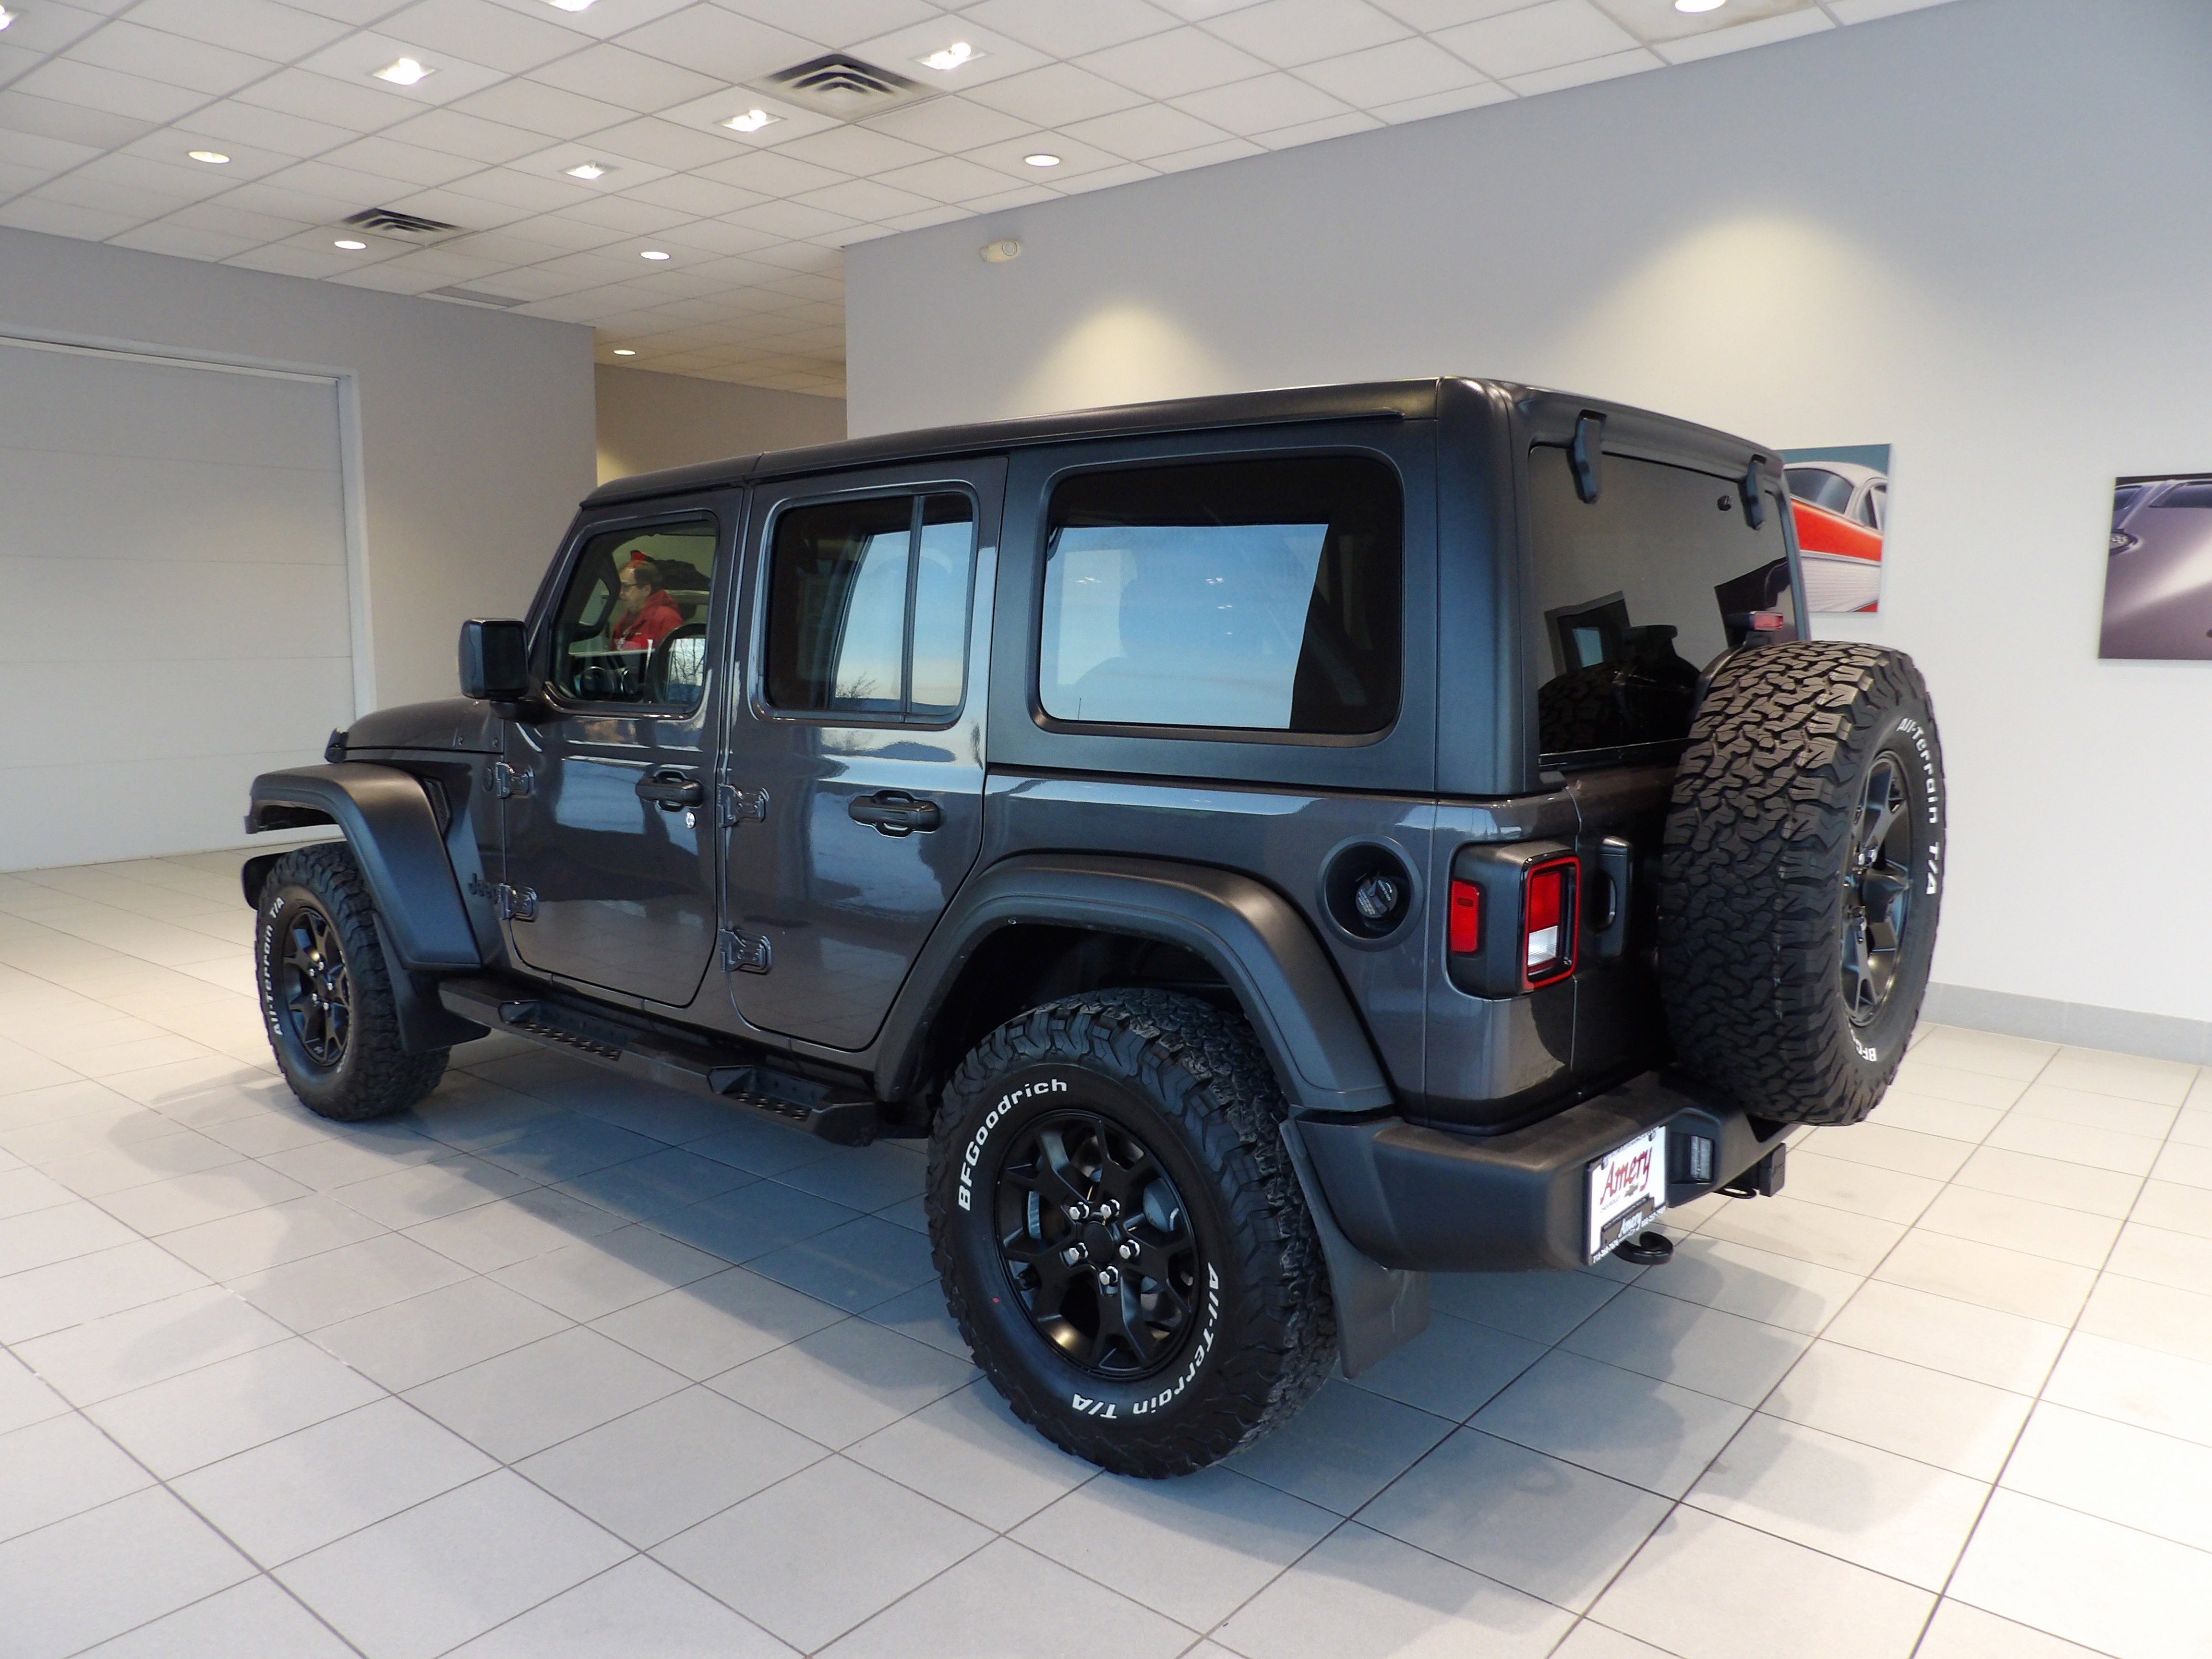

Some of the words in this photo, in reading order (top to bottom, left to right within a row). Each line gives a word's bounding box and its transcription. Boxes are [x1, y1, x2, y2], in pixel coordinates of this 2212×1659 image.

[1896, 718, 1938, 823] All-Terrain
[1926, 842, 1940, 895] T/A
[269, 896, 284, 918] T/A
[264, 925, 283, 1035] All-Terrain
[958, 1079, 1067, 1211] BFGoodrich
[1599, 1146, 1653, 1206] Amery
[1132, 1262, 1220, 1416] All-Terrain
[1071, 1392, 1118, 1419] T/A
